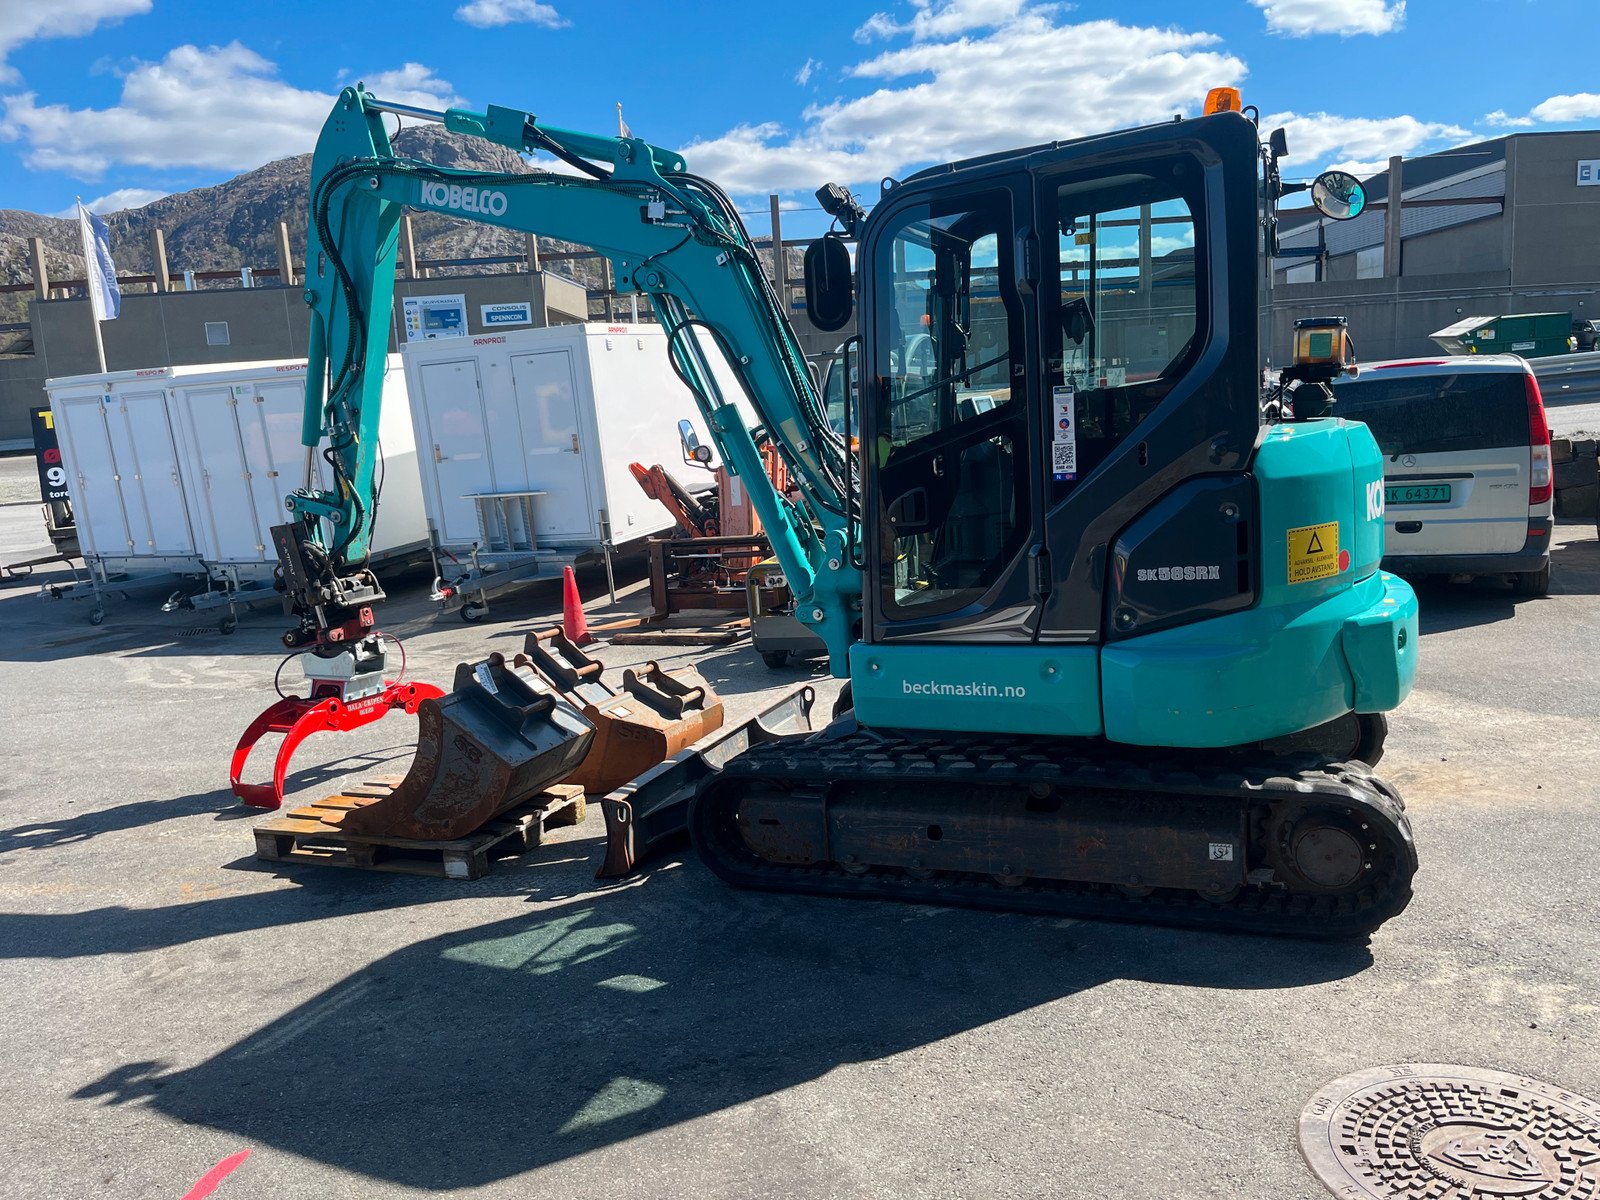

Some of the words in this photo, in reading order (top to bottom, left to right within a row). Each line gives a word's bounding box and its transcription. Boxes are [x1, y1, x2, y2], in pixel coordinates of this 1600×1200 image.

[421, 180, 508, 217] KOBELCO
[490, 314, 523, 322] SPENNCON
[473, 337, 502, 346] ARNPRO
[276, 365, 300, 373] RESPO
[38, 411, 54, 429] T
[47, 466, 67, 487] 9
[1405, 487, 1446, 500] 64371
[1137, 565, 1220, 581] SK58SRX
[1294, 567, 1311, 577] HOLD
[1311, 562, 1335, 574] AVSTAND
[902, 680, 1026, 698] beckmaskin.no
